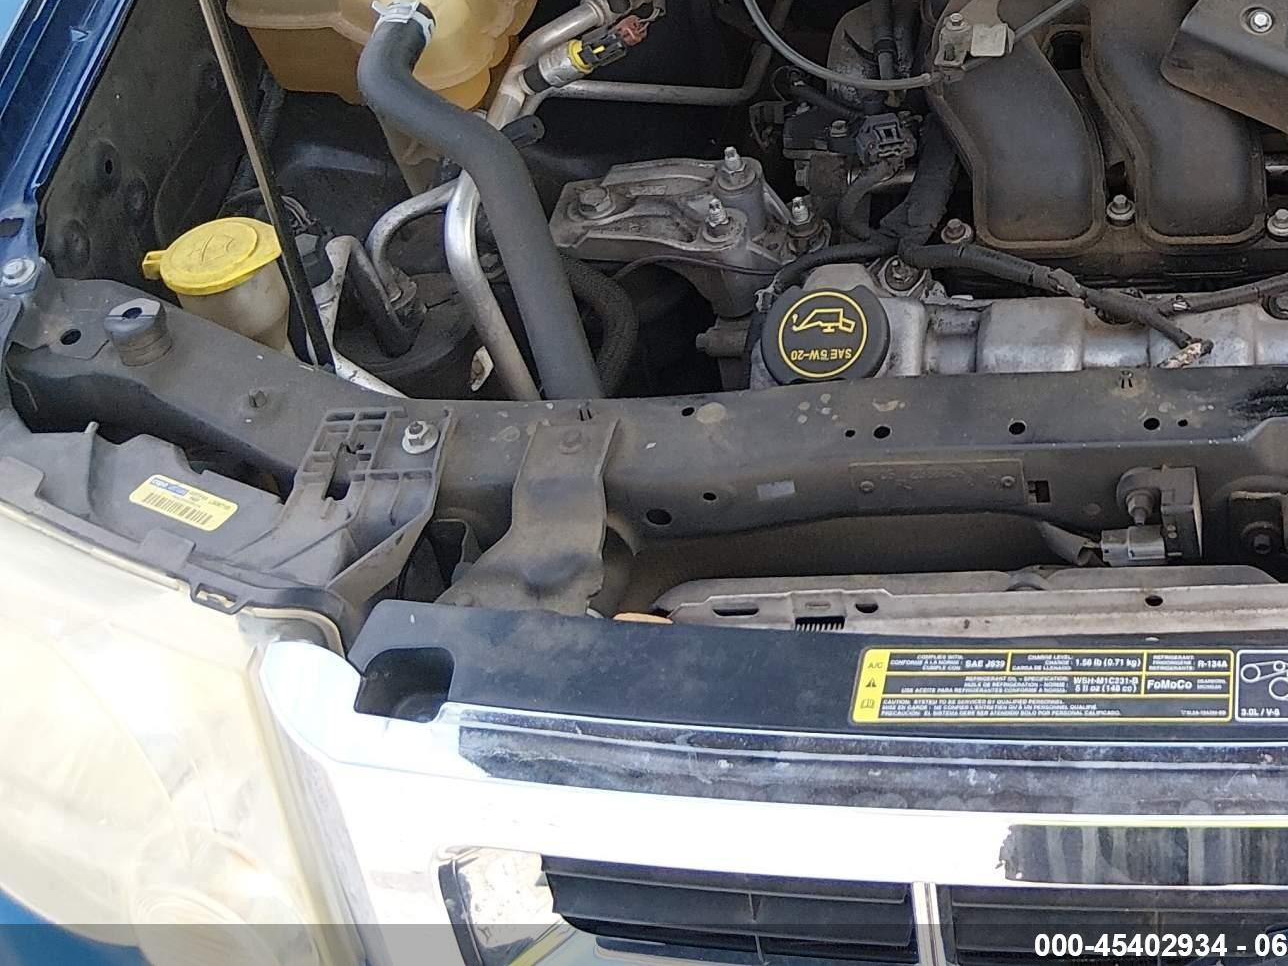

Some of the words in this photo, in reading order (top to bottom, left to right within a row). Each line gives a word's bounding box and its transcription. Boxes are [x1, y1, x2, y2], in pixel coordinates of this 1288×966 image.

[791, 349, 829, 361] 5W-20
[831, 348, 852, 360] SAE
[965, 660, 984, 669] SAE
[1094, 658, 1102, 668] lb
[1103, 658, 1124, 668] (0.71
[1126, 658, 1141, 668] kg)
[1197, 660, 1228, 668] R-134A
[1147, 679, 1193, 690] FoMoCo
[1241, 708, 1259, 716] 3.0L
